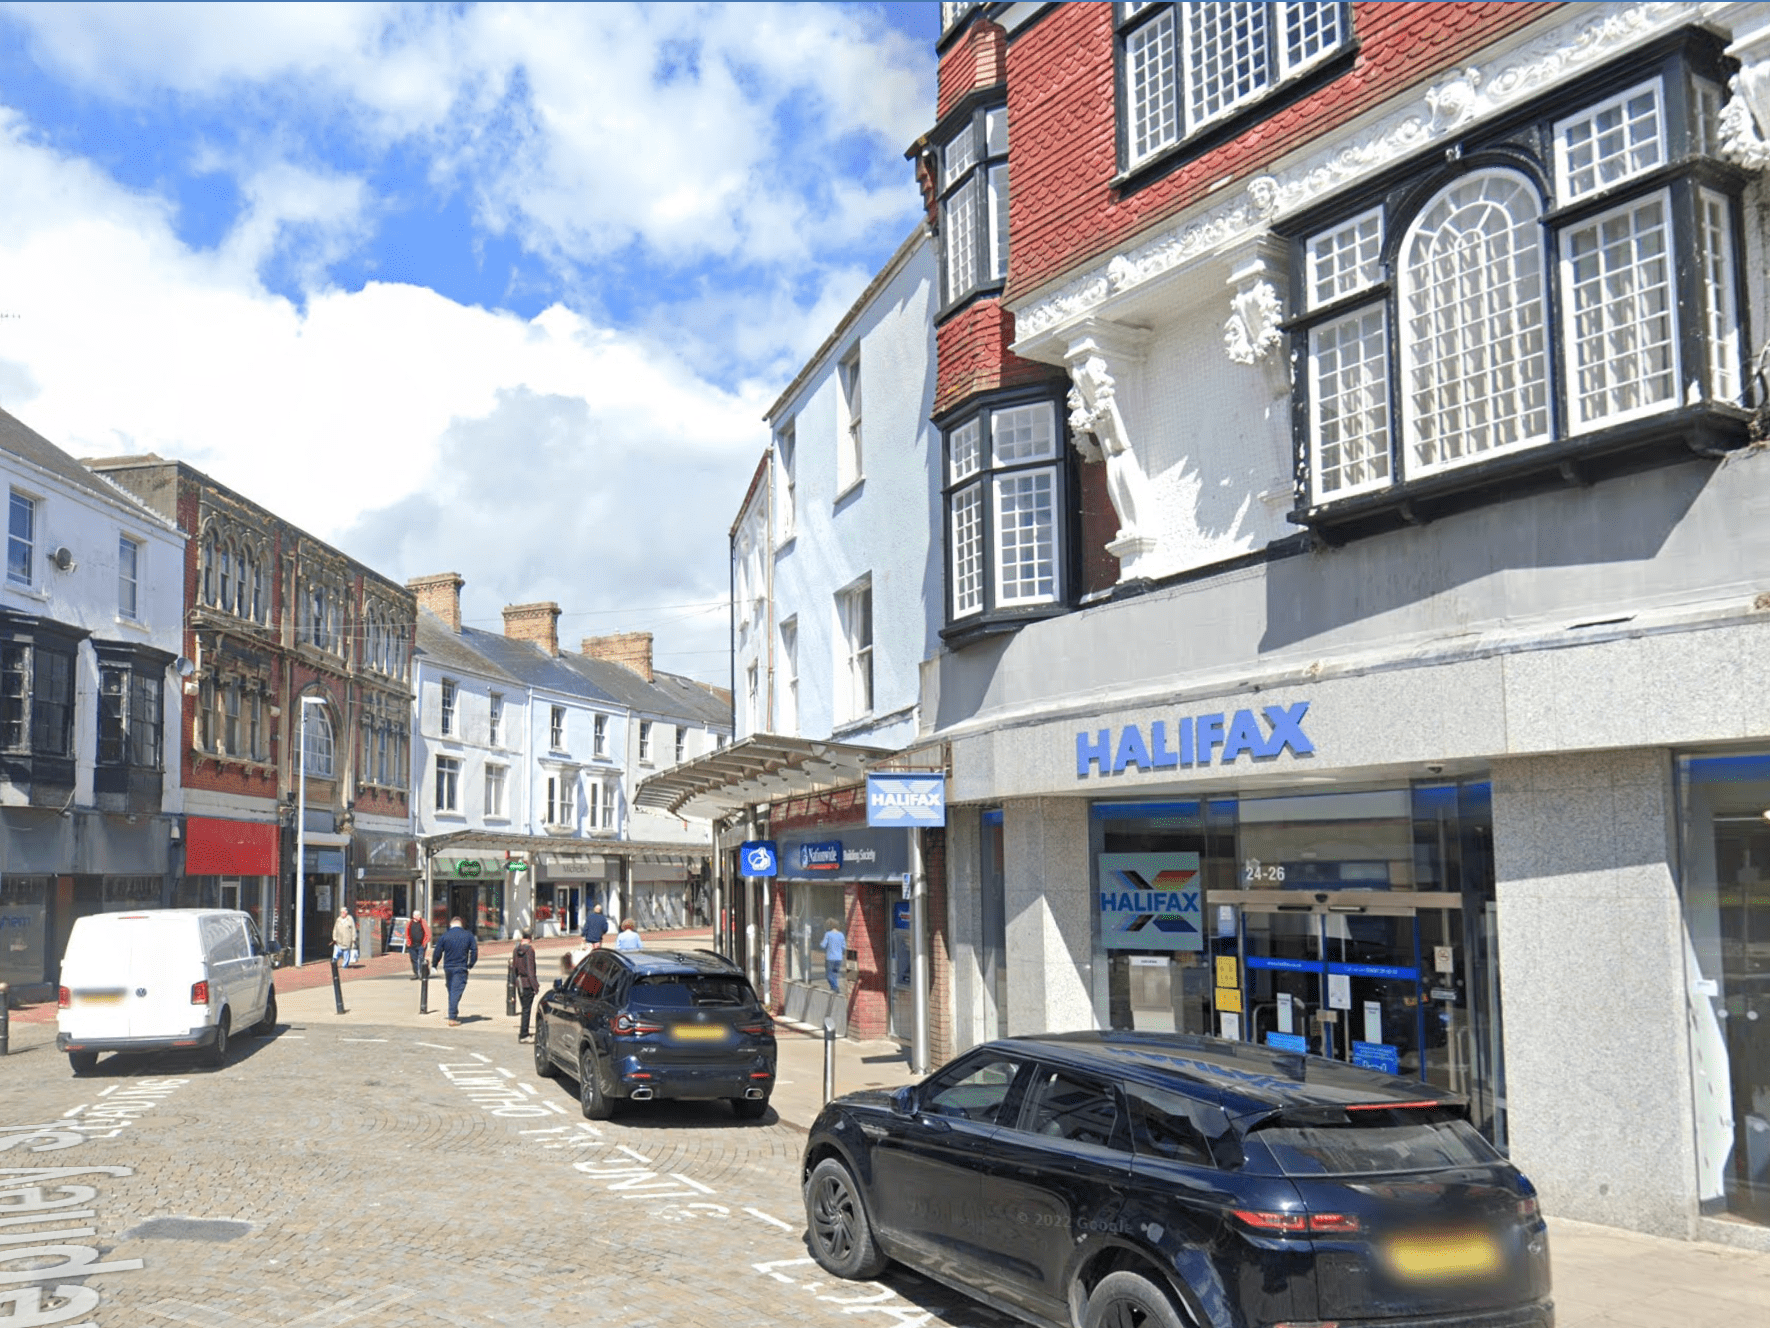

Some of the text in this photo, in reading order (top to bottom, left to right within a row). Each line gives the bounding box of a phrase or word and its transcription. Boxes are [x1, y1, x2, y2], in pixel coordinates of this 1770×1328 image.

[1076, 701, 1316, 779] HALIFAX
[871, 793, 941, 807] HALIFAX
[808, 846, 837, 862] Nationwide
[1246, 866, 1286, 881] 24-26
[1101, 892, 1200, 913] HALIFAX
